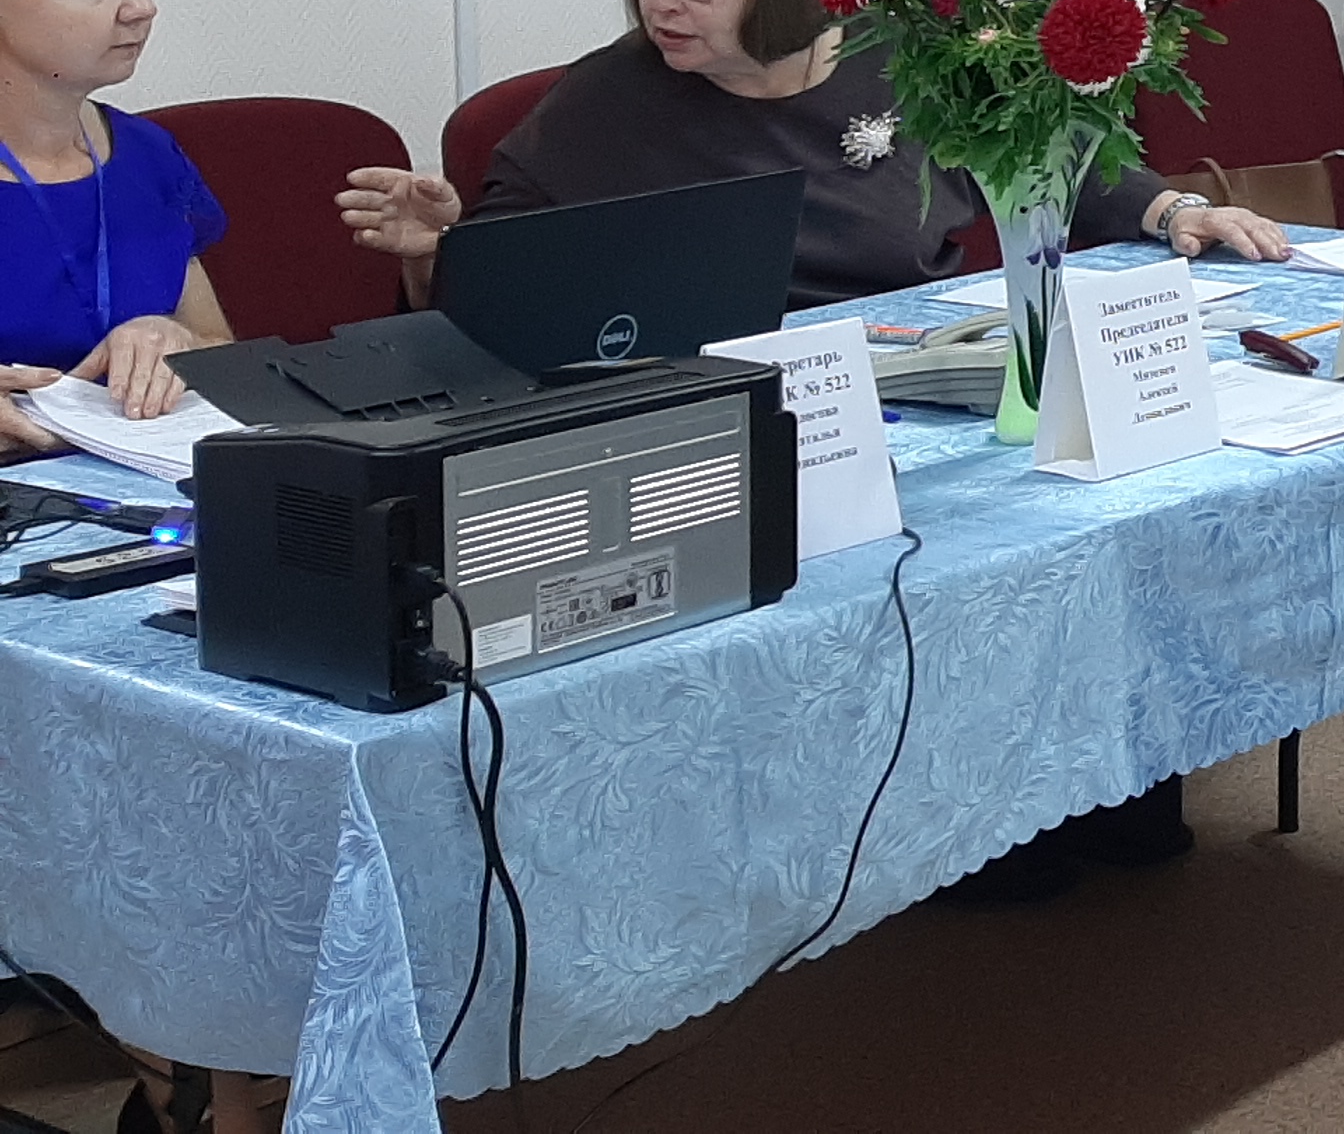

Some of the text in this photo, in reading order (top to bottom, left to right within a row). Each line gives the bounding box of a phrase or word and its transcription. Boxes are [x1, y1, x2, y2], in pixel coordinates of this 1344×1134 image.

[1099, 289, 1181, 318] Заместитель
[1100, 313, 1189, 345] Председателя
[1113, 335, 1187, 367] УИК № 522
[824, 372, 851, 394] 522
